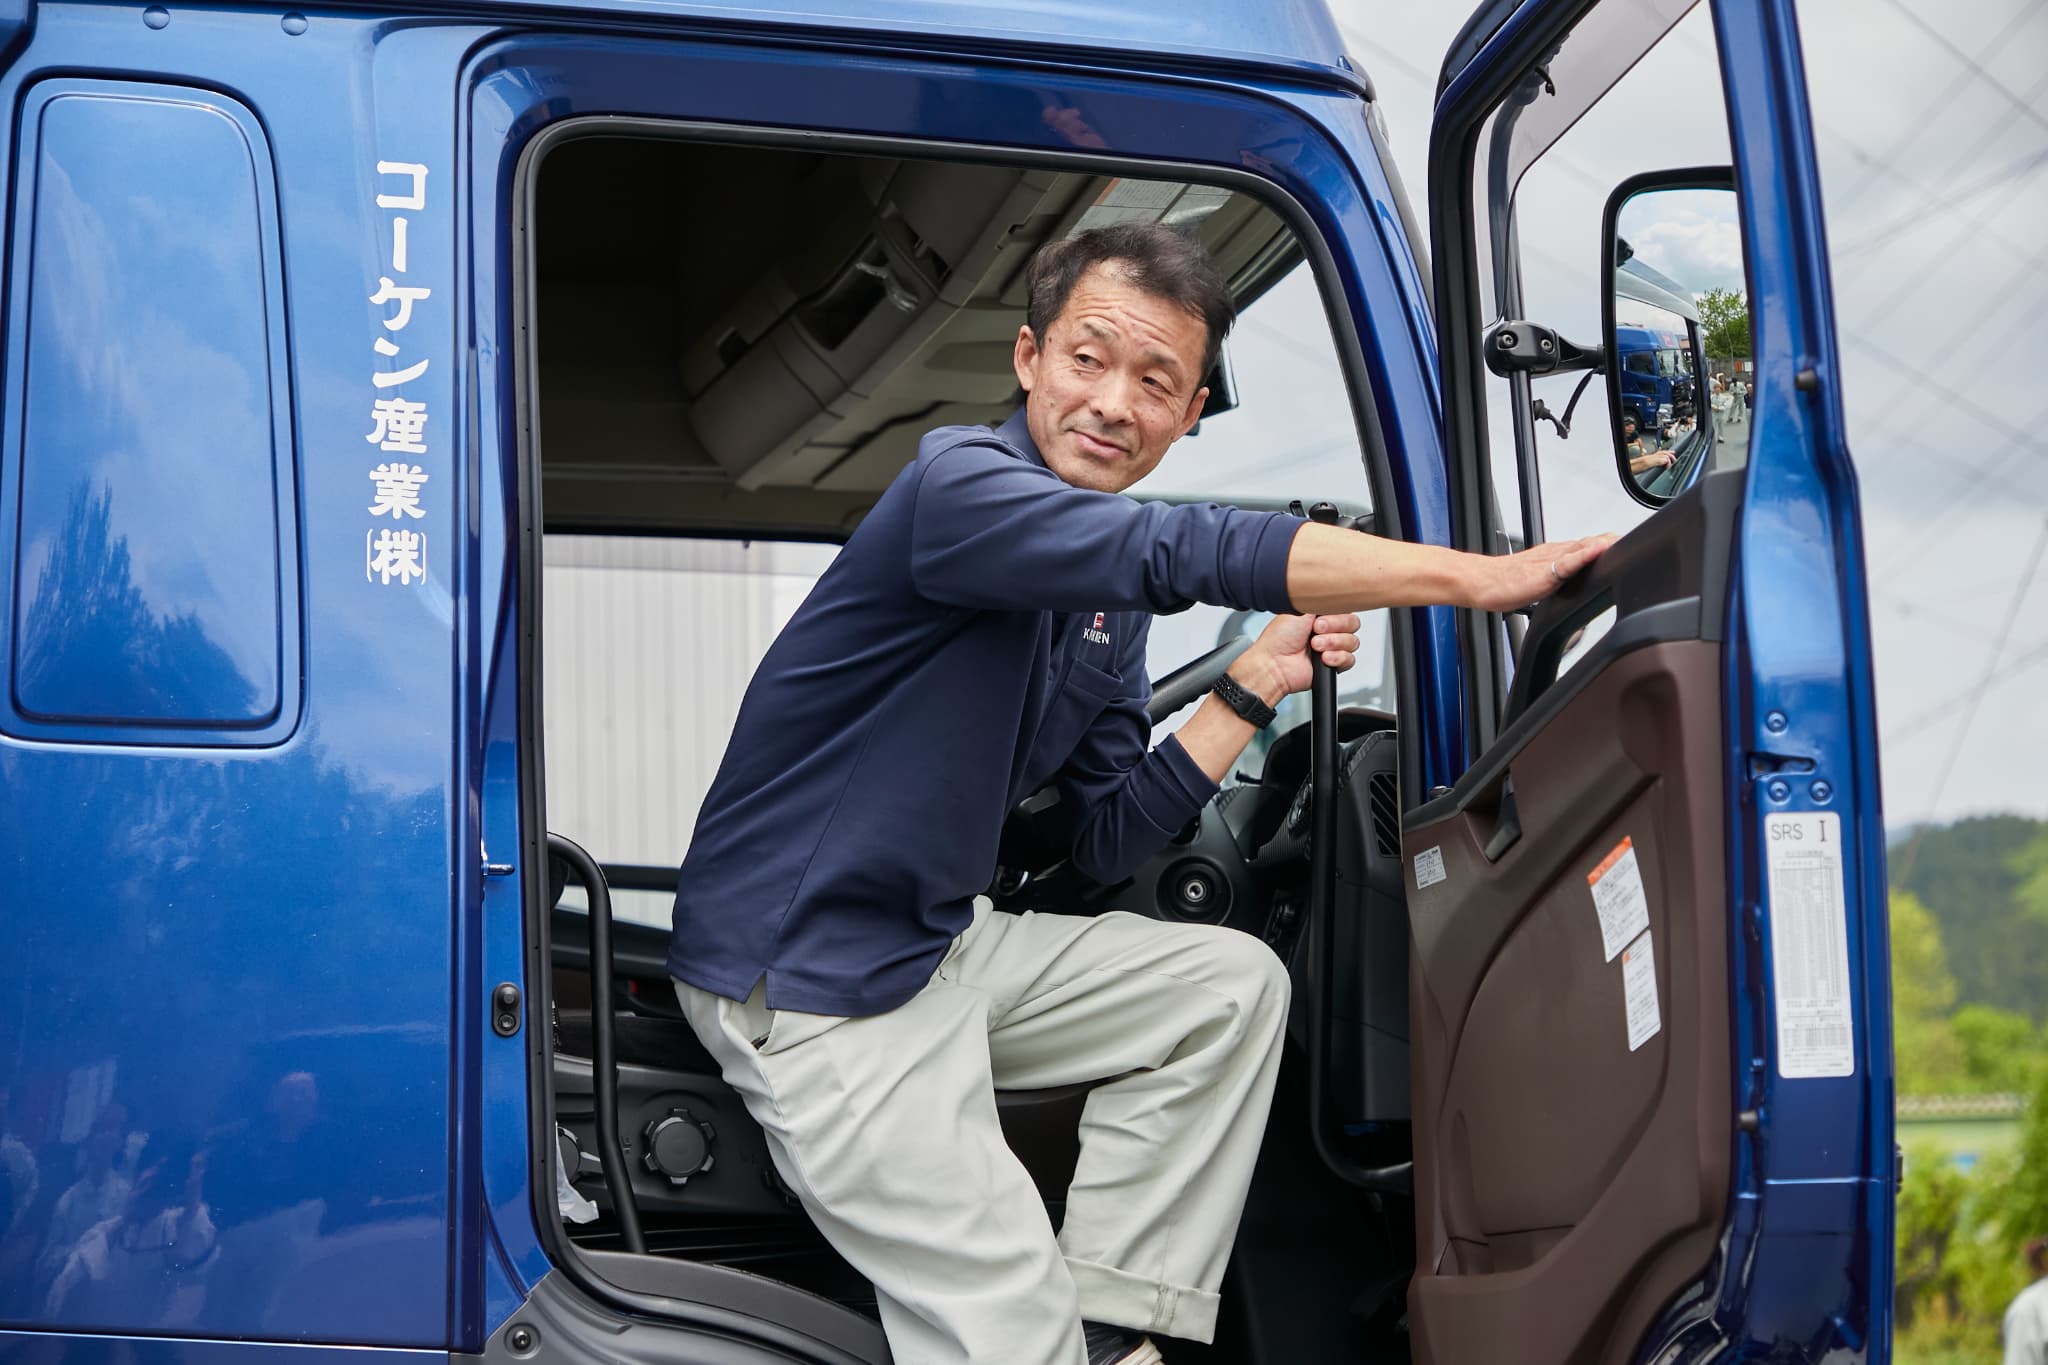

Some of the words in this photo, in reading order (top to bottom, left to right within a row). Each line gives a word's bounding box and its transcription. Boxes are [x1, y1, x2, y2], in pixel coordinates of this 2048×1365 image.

[366, 160, 432, 586] コーケン産業(株)
[1771, 823, 1804, 841] SRS
